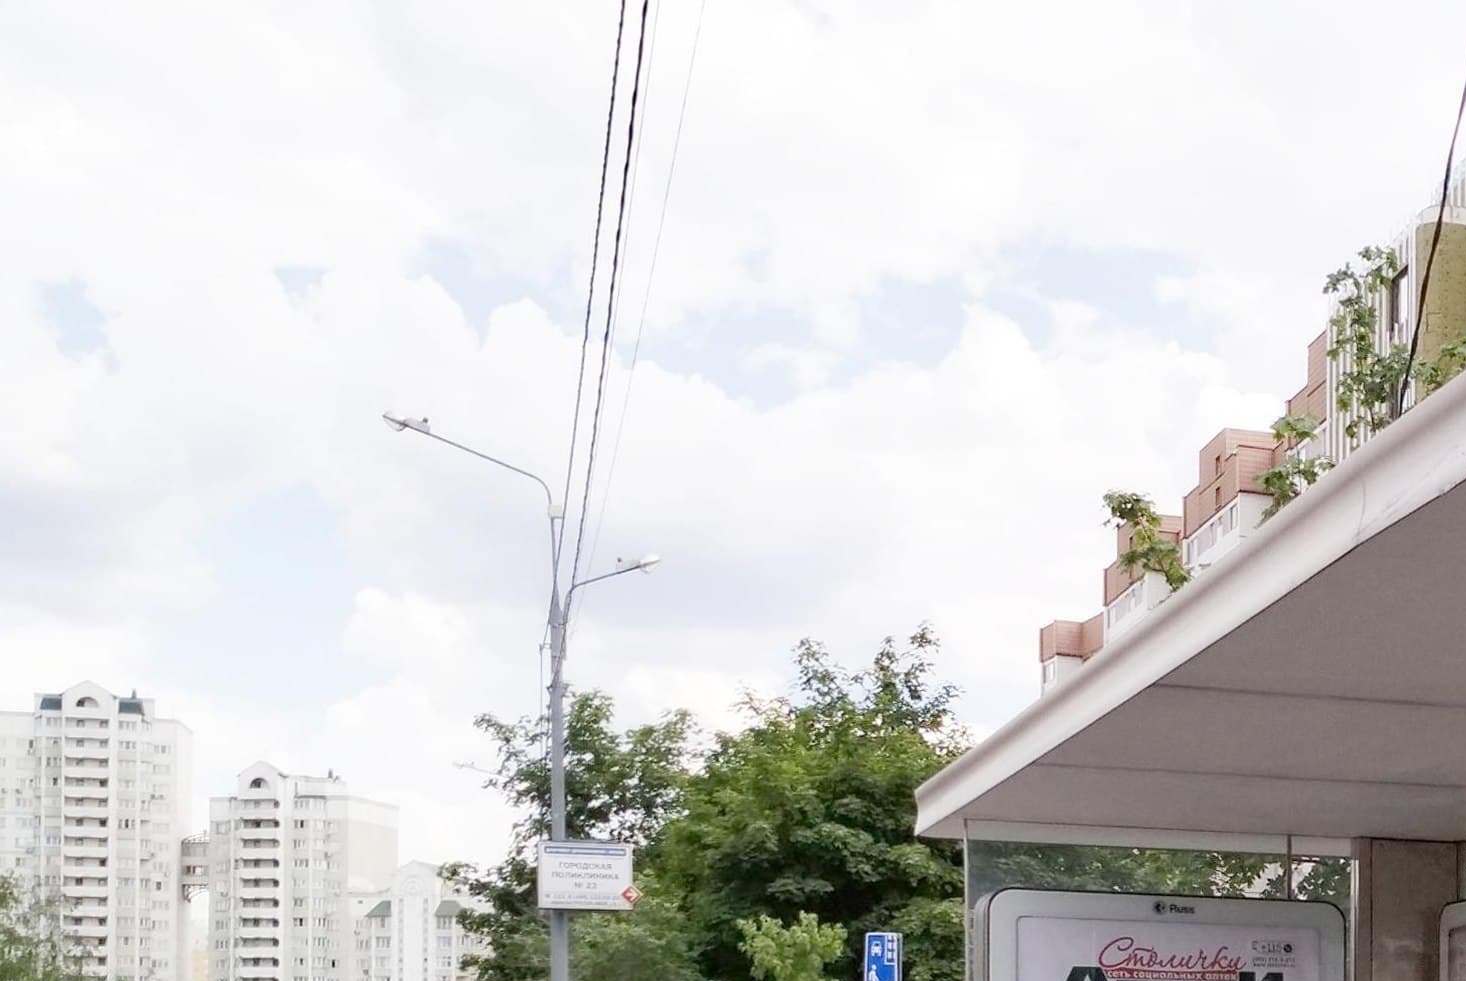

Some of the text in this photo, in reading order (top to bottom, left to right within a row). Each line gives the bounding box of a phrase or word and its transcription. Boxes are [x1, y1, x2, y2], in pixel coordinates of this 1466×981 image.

[558, 861, 613, 871] ГОРОДСКАЯ
[551, 871, 619, 880] ПОЛИКЛИНИКА
[1169, 903, 1196, 915] Russ
[1099, 936, 1248, 971] Столички
[1107, 970, 1237, 981] сеть социальных аптек
